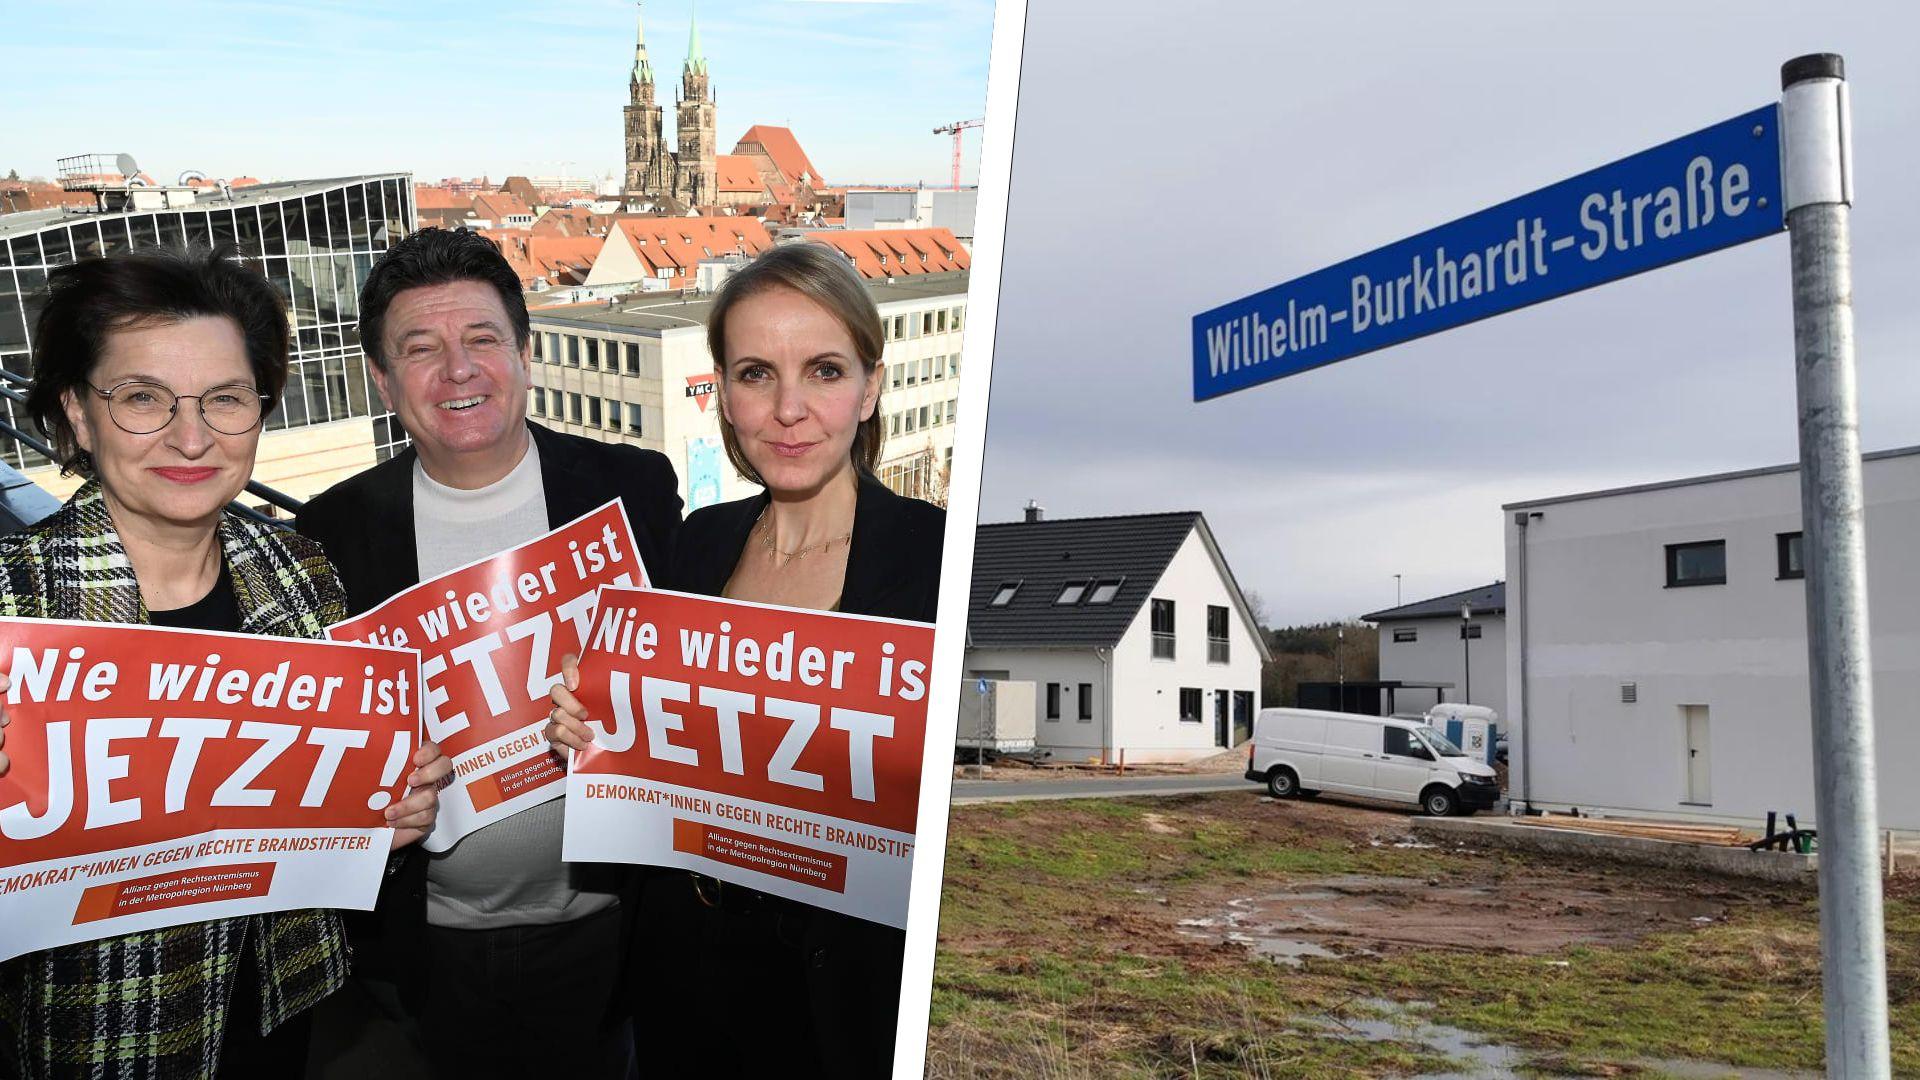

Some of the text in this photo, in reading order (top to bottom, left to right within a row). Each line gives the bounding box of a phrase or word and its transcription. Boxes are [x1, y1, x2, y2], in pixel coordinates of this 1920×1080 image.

[1206, 154, 1750, 378] Wilhelm-Burkhardt-Straße
[418, 561, 557, 643] wieder
[568, 522, 623, 580] ist
[592, 606, 659, 660] Nie
[679, 621, 855, 690] wieder
[7, 647, 410, 715] Nie wieder ist
[498, 732, 540, 759] GEGEN
[585, 670, 895, 803] JETZT
[500, 770, 524, 784] Allianz
[525, 762, 546, 775] gegen
[504, 785, 511, 793] in
[511, 781, 523, 790] der
[716, 803, 762, 827] GEGEN
[766, 813, 821, 840] RECHTE
[143, 844, 193, 868] GEGEN
[195, 838, 255, 858] RECHTE
[258, 836, 372, 853] BRANDSTIFTER!
[708, 832, 833, 869] Allianz gegen Rechtsextremismus
[708, 842, 715, 850] in
[716, 845, 729, 855] der
[730, 849, 788, 869] Metropolregion
[118, 882, 252, 907] in der Metropolregion Nürnberg
[122, 870, 260, 895] Allianz gegen Rechtsextremismus
